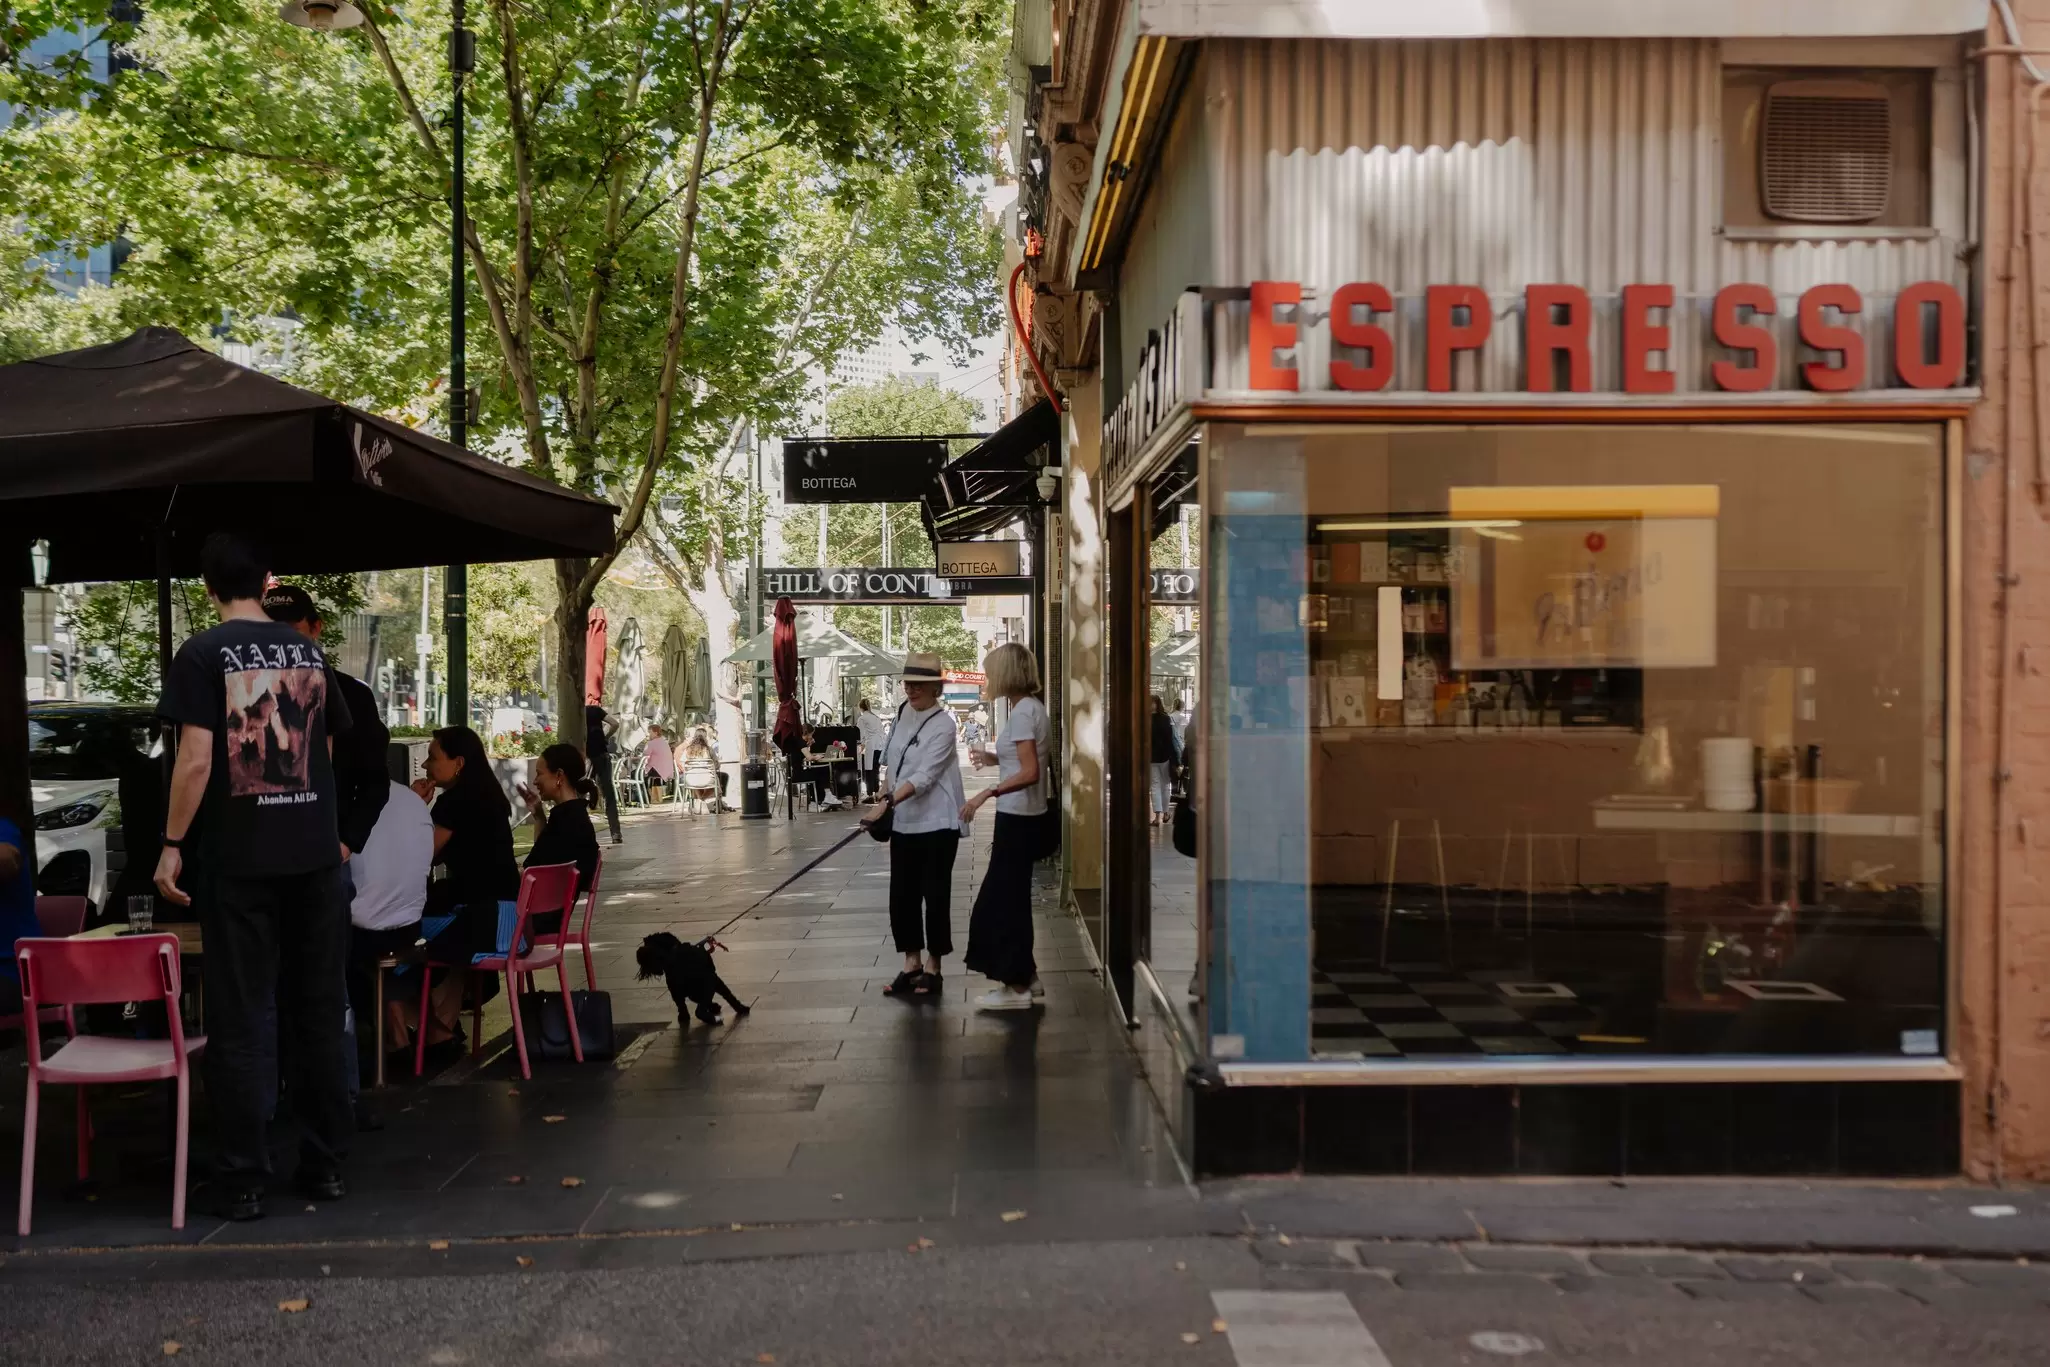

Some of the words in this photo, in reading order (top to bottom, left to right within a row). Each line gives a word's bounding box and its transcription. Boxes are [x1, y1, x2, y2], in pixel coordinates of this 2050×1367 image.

[1249, 281, 1966, 393] ESPRESSO
[802, 477, 857, 489] BOTTEGA
[942, 562, 998, 574] BOTTEGA
[764, 573, 822, 594] HILL
[828, 573, 860, 594] OF
[220, 643, 324, 673] NAILS
[257, 793, 293, 806] Abandon
[294, 792, 306, 804] All
